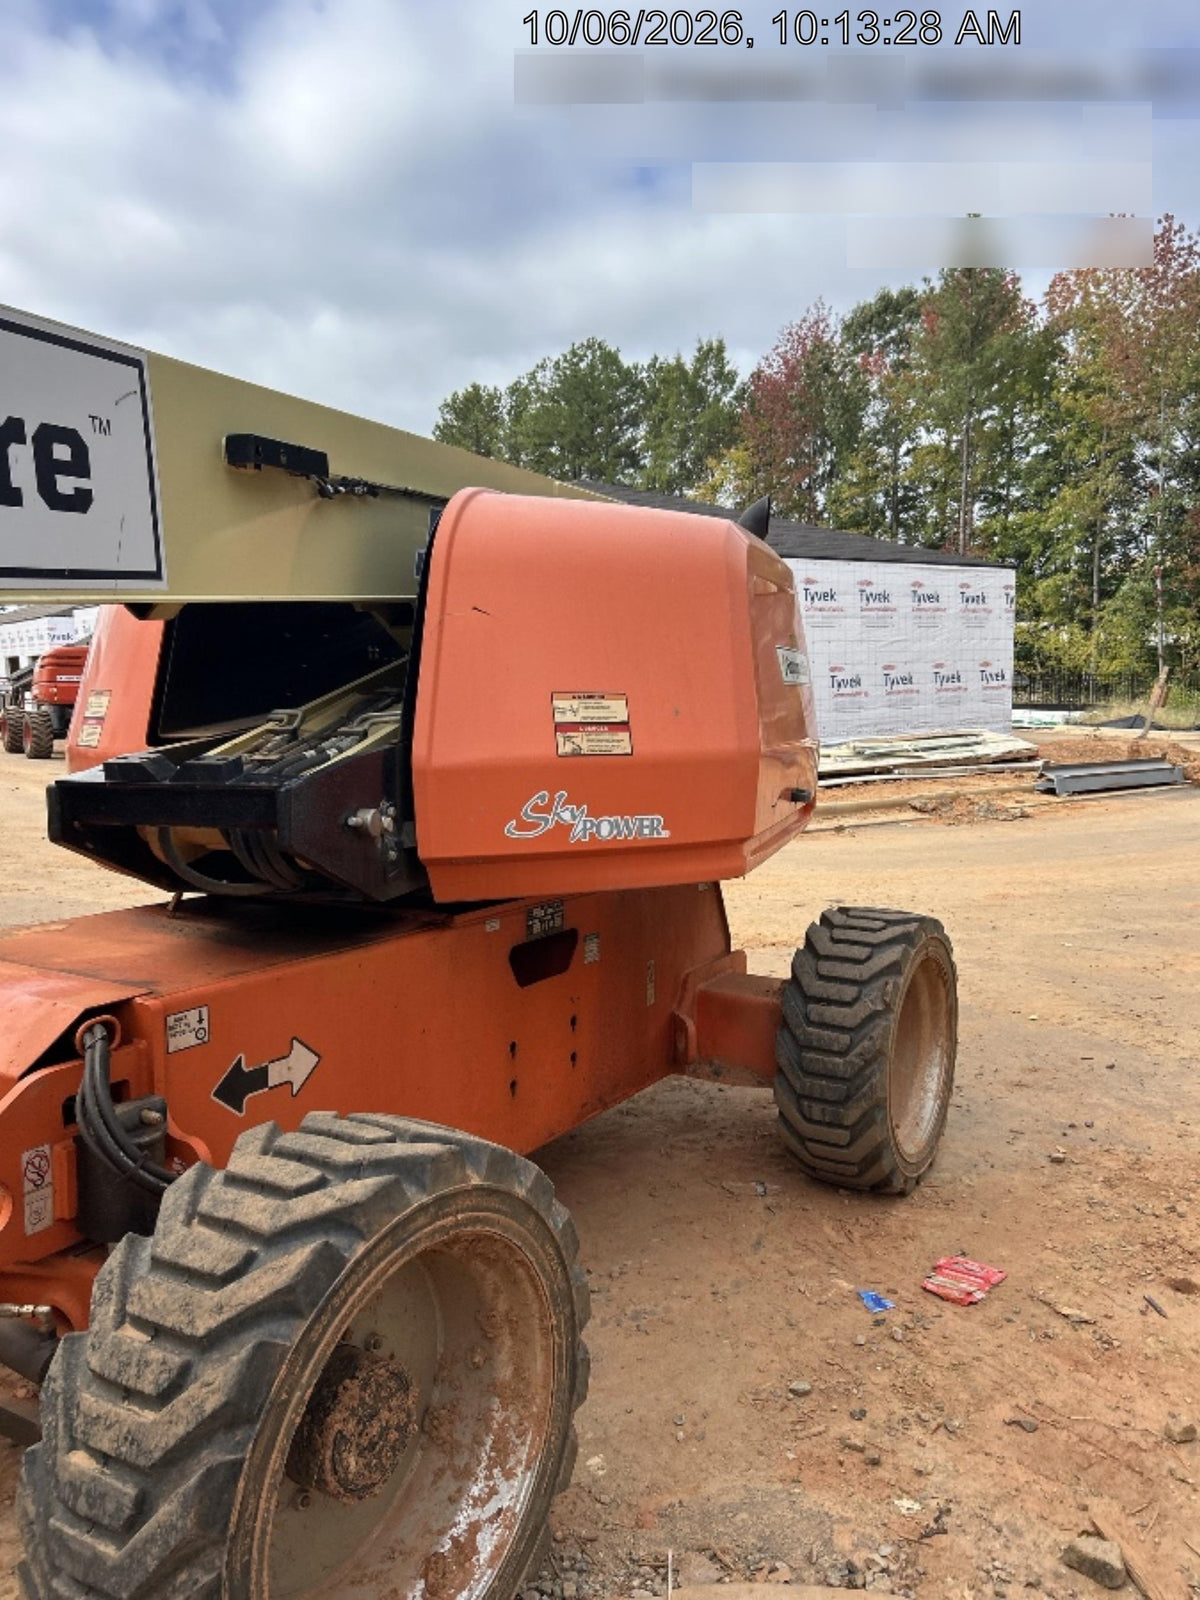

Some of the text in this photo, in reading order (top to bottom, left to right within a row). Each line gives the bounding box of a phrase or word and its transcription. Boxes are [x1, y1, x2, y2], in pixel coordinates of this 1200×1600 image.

[803, 588, 836, 604] Tyvek
[859, 590, 890, 606] Tyvek
[912, 590, 940, 606] Tyvek
[960, 592, 986, 608] Tyvek
[830, 674, 861, 692] Tyvek
[883, 672, 912, 690] Tyvek
[933, 670, 961, 686] Tyvek
[980, 669, 1006, 684] Tyvek
[505, 791, 664, 843] Sky POWER
